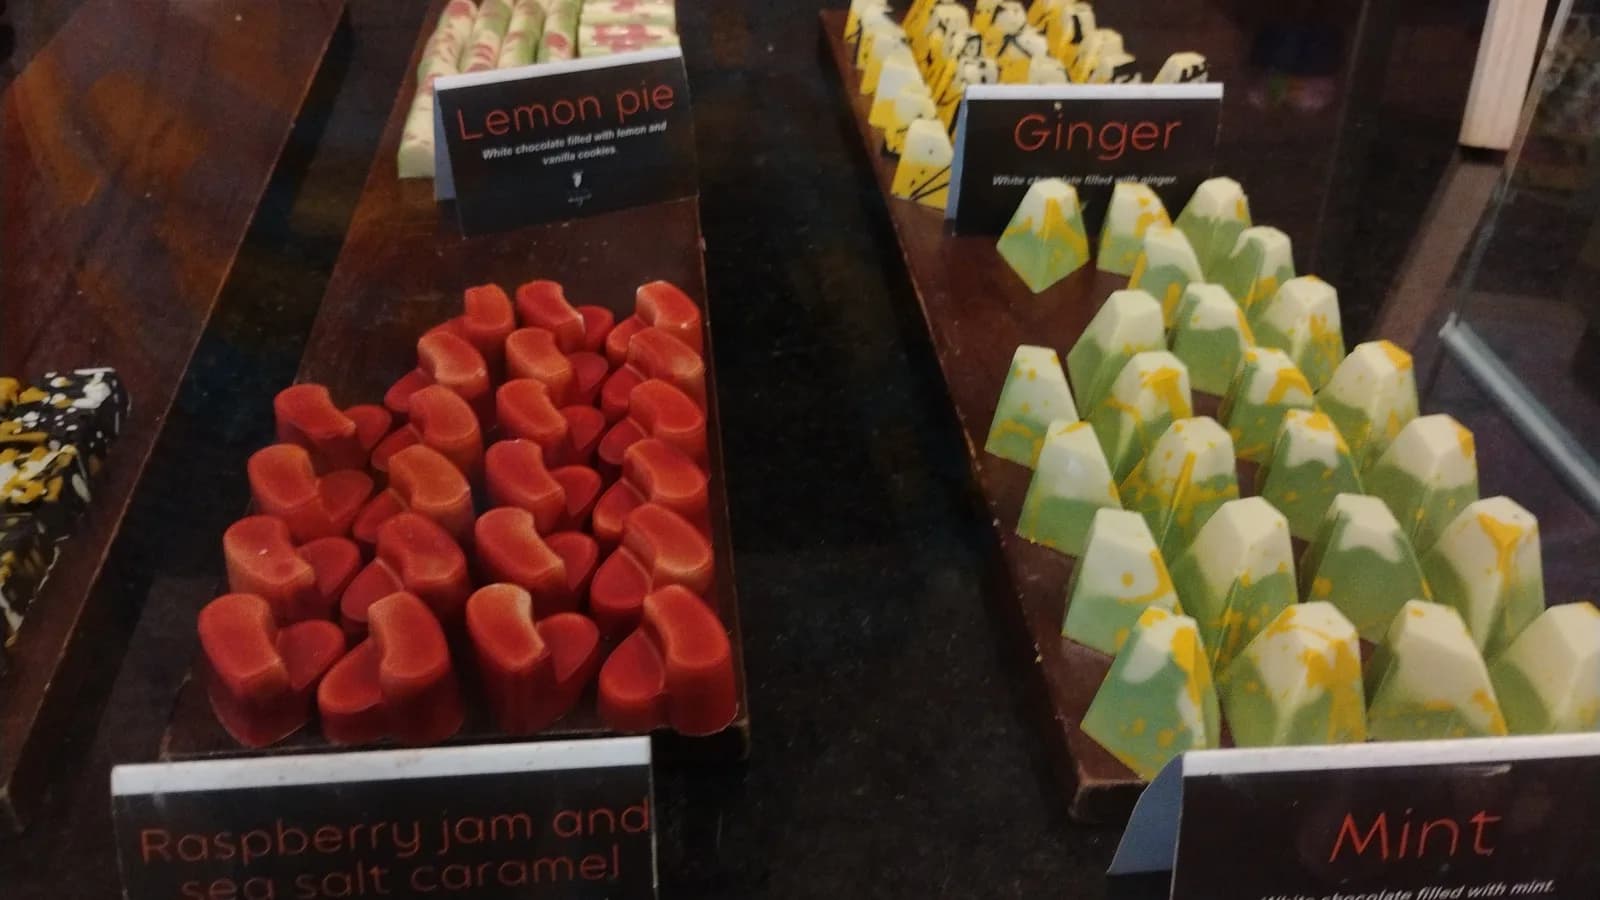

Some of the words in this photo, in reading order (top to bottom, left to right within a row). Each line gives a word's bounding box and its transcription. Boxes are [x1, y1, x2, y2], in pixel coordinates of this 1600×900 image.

[456, 94, 602, 141] Lemon
[616, 80, 675, 124] pie
[482, 147, 513, 161] White
[515, 139, 565, 155] chocolate
[567, 132, 593, 146] filled
[594, 128, 615, 142] with
[616, 126, 647, 139] lemon
[648, 120, 668, 132] and
[542, 150, 576, 166] vanilla
[1013, 112, 1182, 161] Ginger
[992, 174, 1025, 186] White
[1084, 173, 1114, 185] filled
[140, 817, 421, 866] Raspberry
[437, 808, 533, 856] jam
[552, 794, 650, 838] and
[1328, 808, 1502, 864] Mint
[181, 877, 275, 900] sea
[295, 860, 391, 899] salt
[410, 844, 621, 893] caramel
[1416, 884, 1466, 900] filled
[1467, 880, 1508, 899] with
